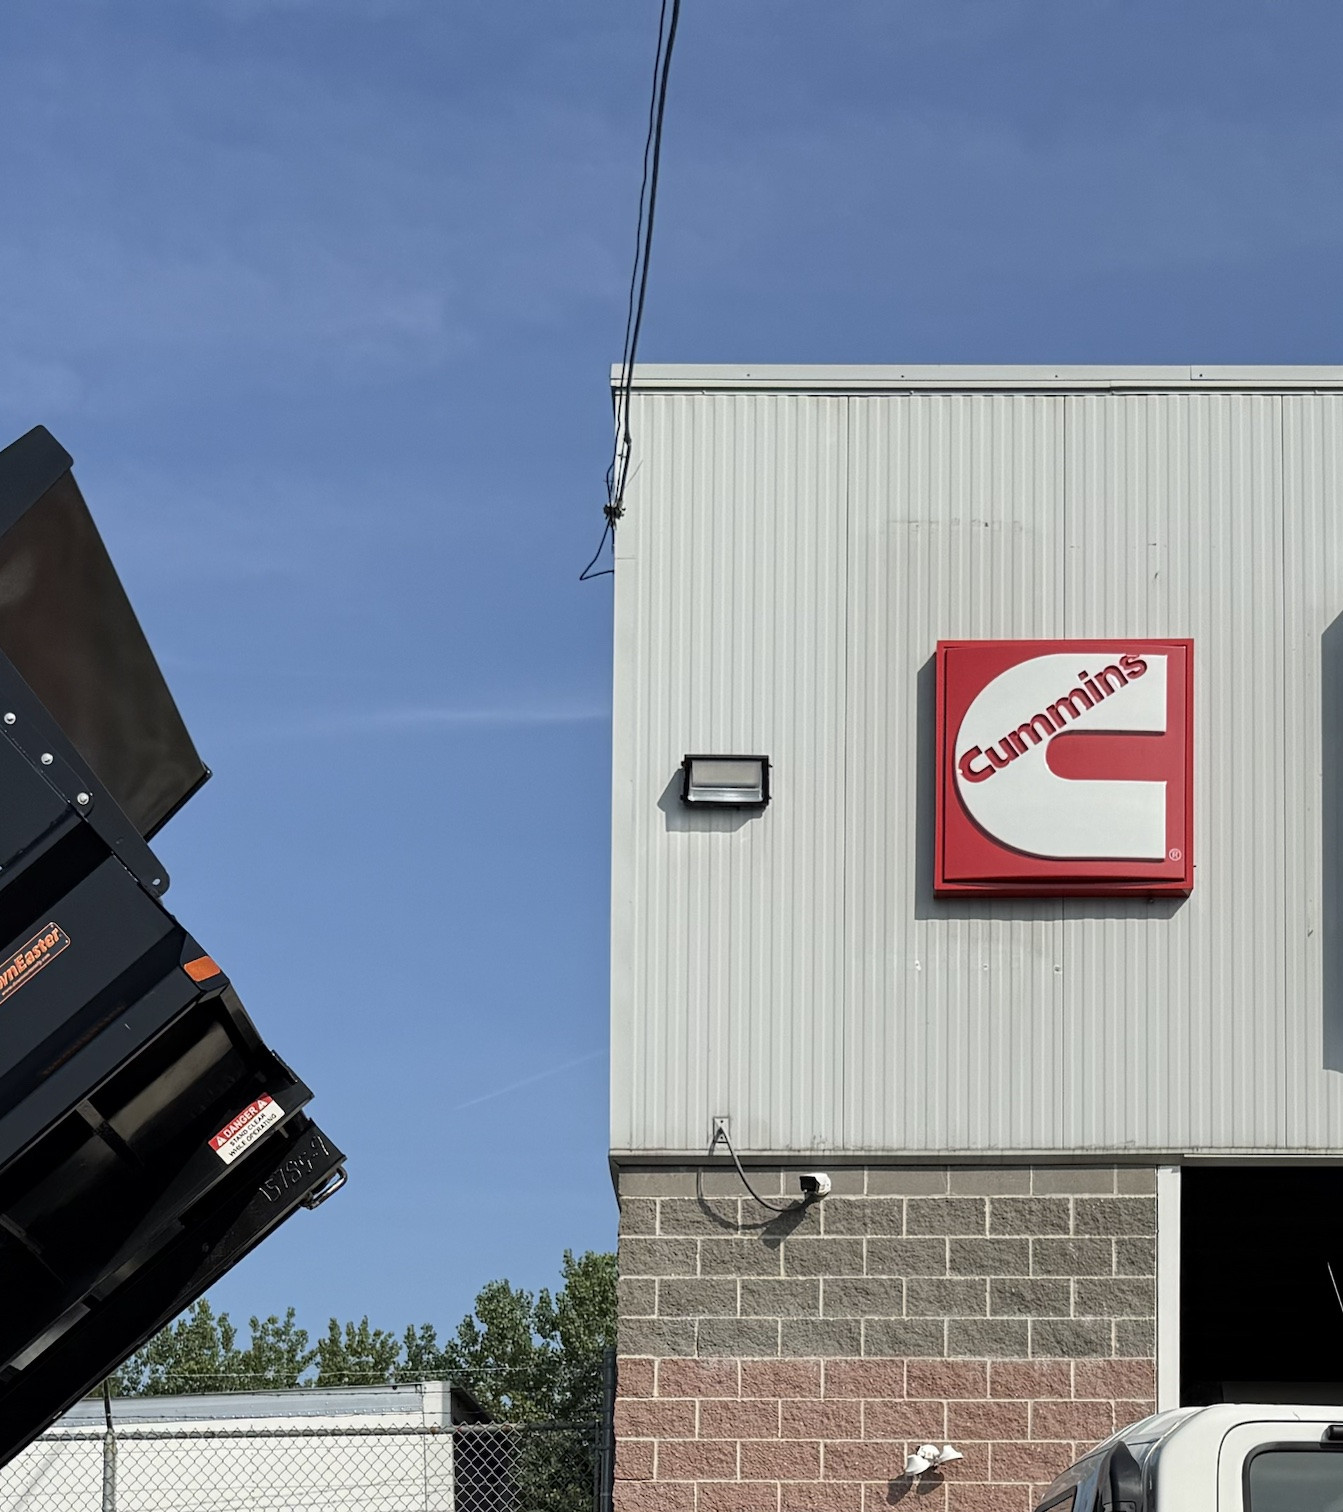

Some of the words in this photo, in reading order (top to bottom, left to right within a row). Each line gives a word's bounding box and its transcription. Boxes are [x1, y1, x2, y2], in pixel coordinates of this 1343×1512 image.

[958, 653, 1148, 784] Cummins
[223, 1105, 259, 1138] DANGER
[229, 1129, 249, 1147] STAND
[247, 1112, 266, 1131] CLEAR
[246, 1112, 277, 1142] OPERATING
